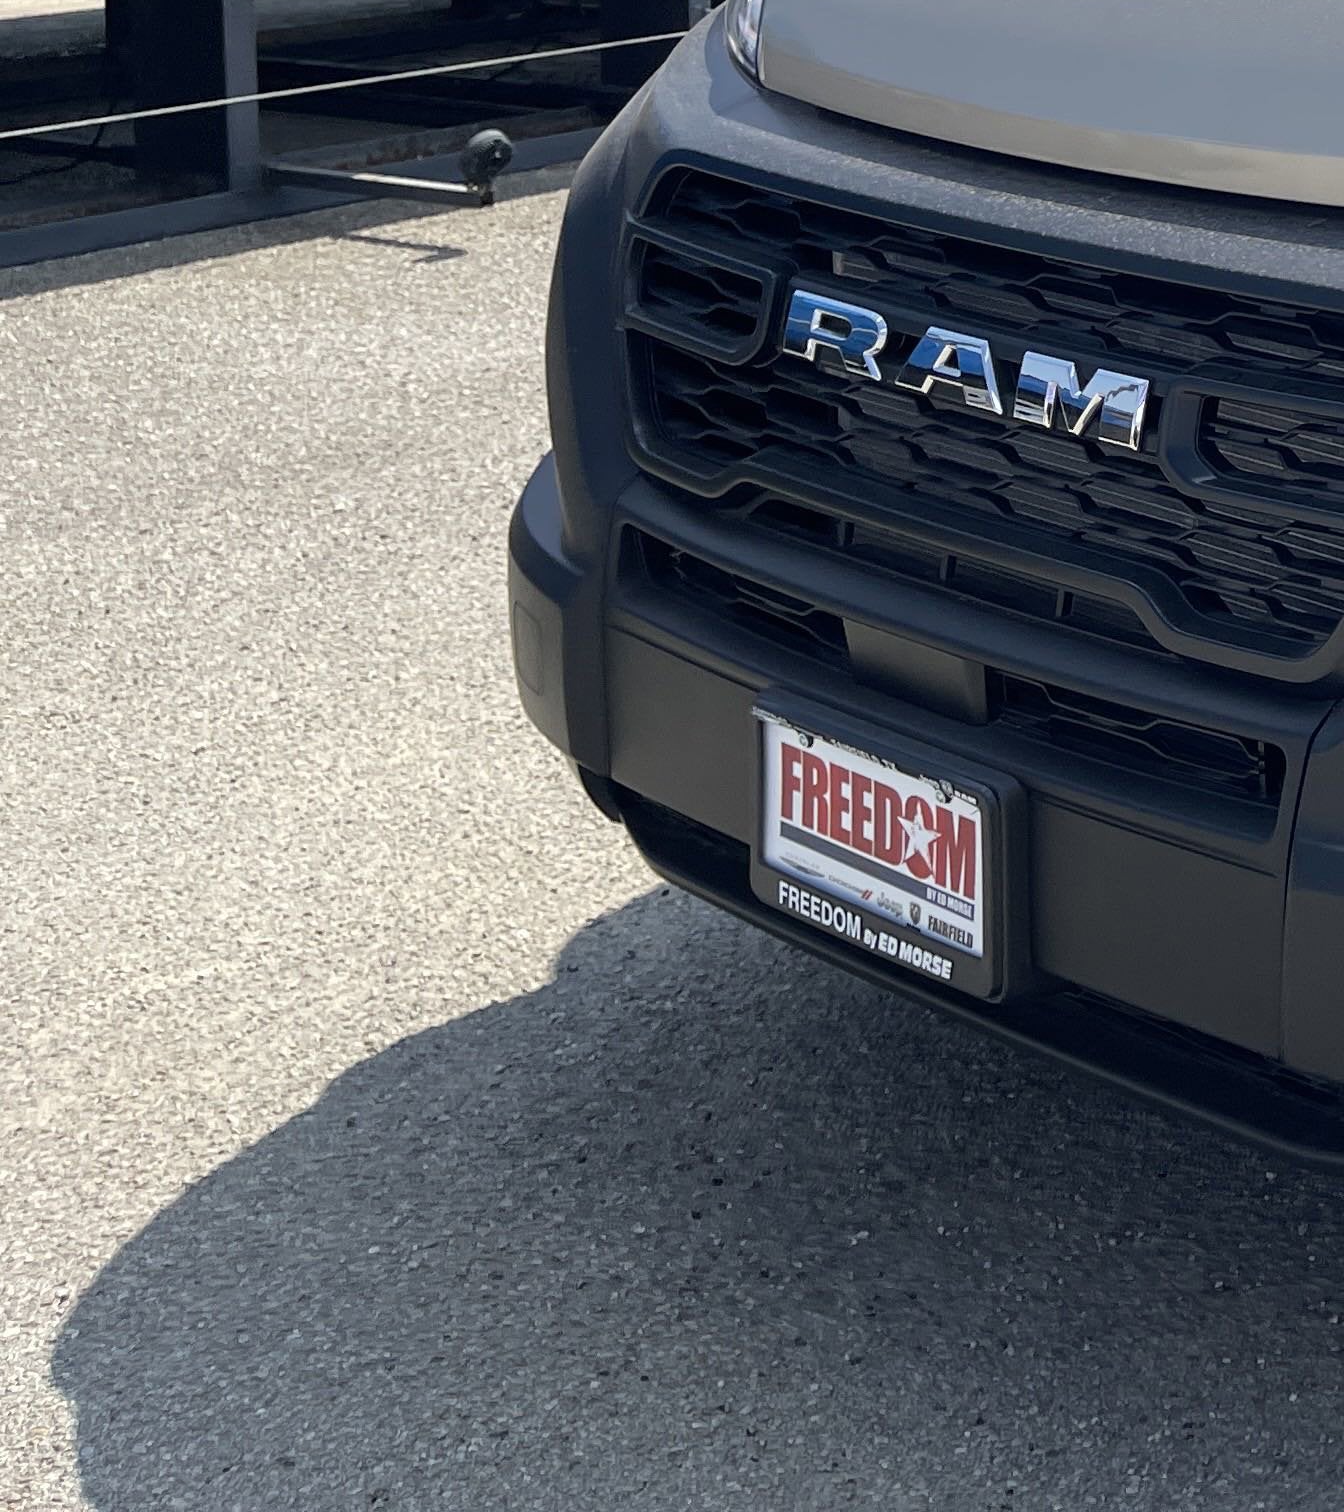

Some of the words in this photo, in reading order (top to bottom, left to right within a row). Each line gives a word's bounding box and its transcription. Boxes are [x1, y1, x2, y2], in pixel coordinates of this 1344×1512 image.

[782, 289, 1151, 452] RAM
[780, 741, 977, 901] FREEDOM
[778, 879, 862, 939] FREEDOM
[878, 931, 899, 957] ED
[899, 941, 953, 980] MORSE
[926, 886, 937, 901] BY
[937, 890, 948, 907] ED
[947, 896, 973, 919] MORSE
[928, 914, 974, 948] FAIRFIELD
